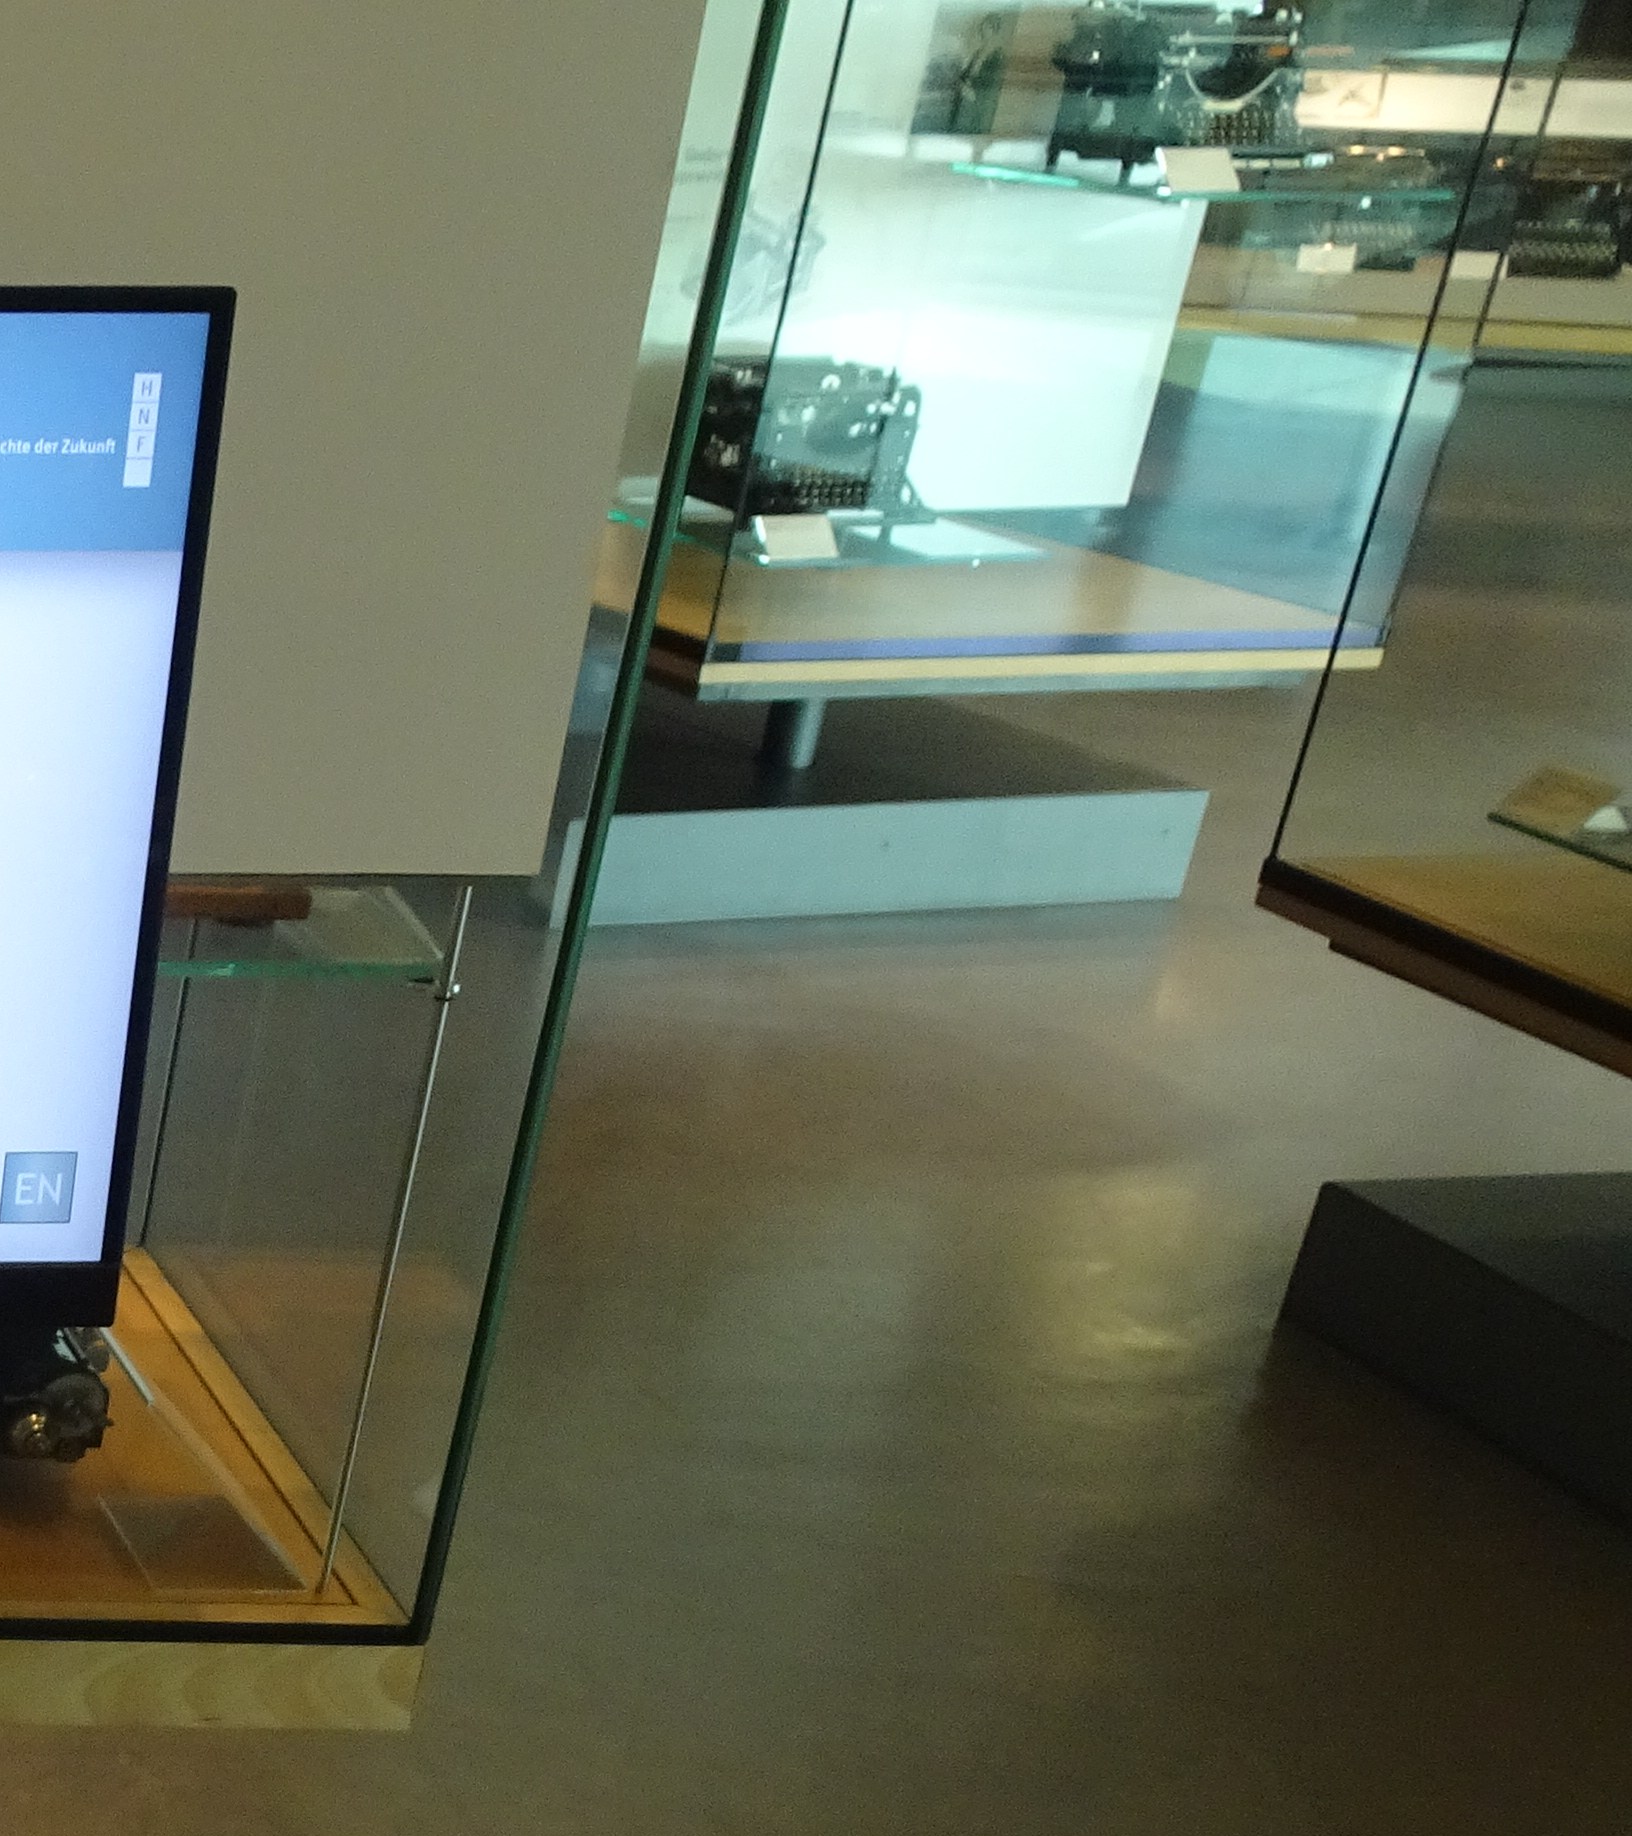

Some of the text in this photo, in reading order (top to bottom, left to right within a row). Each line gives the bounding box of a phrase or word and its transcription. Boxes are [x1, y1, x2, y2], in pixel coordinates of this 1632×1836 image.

[34, 437, 59, 455] der
[61, 437, 117, 455] Zukunft
[14, 1172, 64, 1206] EN
